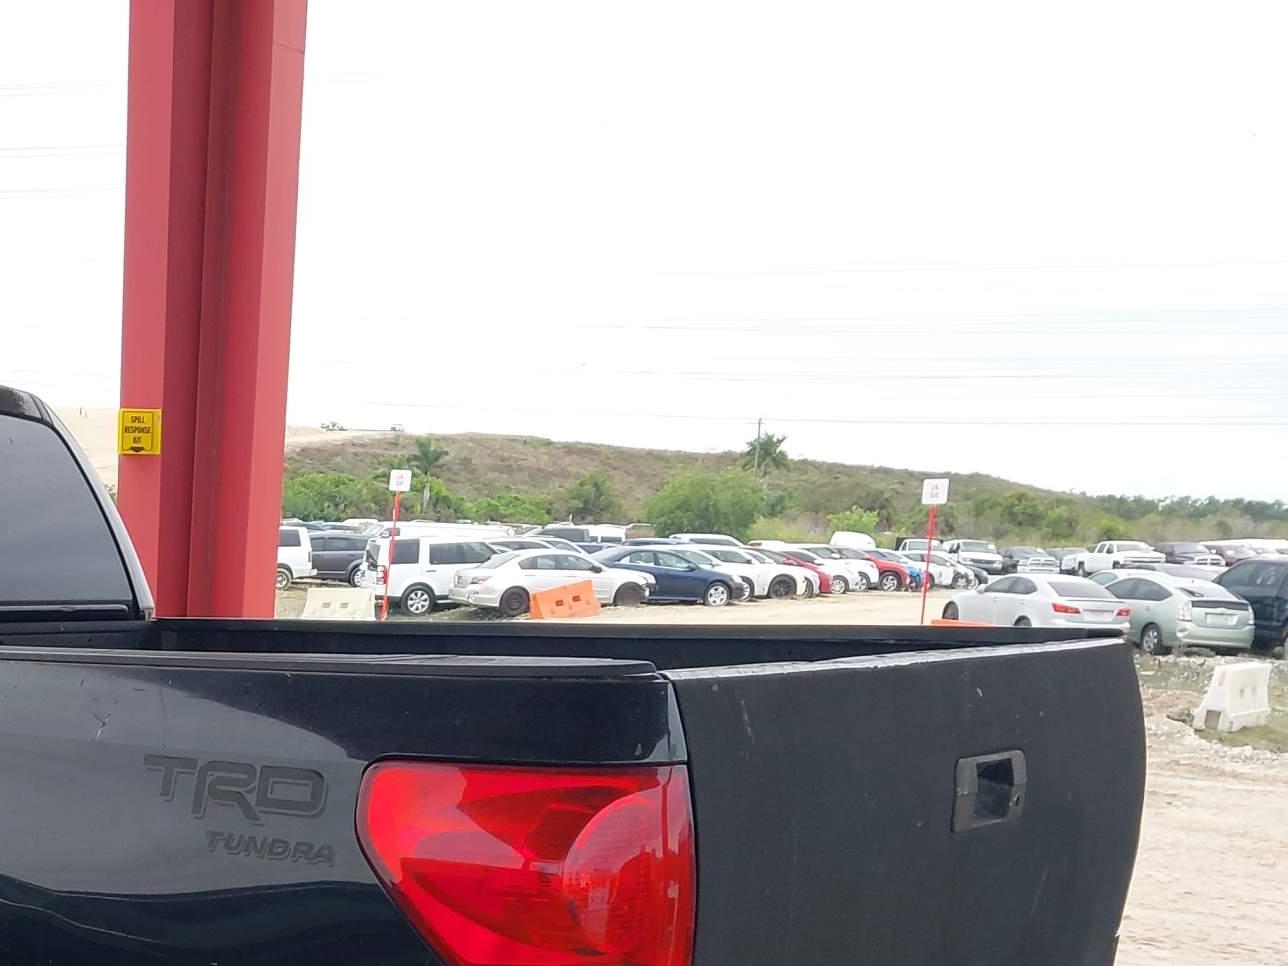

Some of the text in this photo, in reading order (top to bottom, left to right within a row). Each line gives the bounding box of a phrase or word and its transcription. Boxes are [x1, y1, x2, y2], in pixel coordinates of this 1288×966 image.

[130, 415, 145, 424] SPILL
[124, 426, 151, 434] RESPONSE
[132, 436, 142, 444] KIT
[143, 753, 327, 826] TRD
[206, 829, 336, 867] TUNDRA
